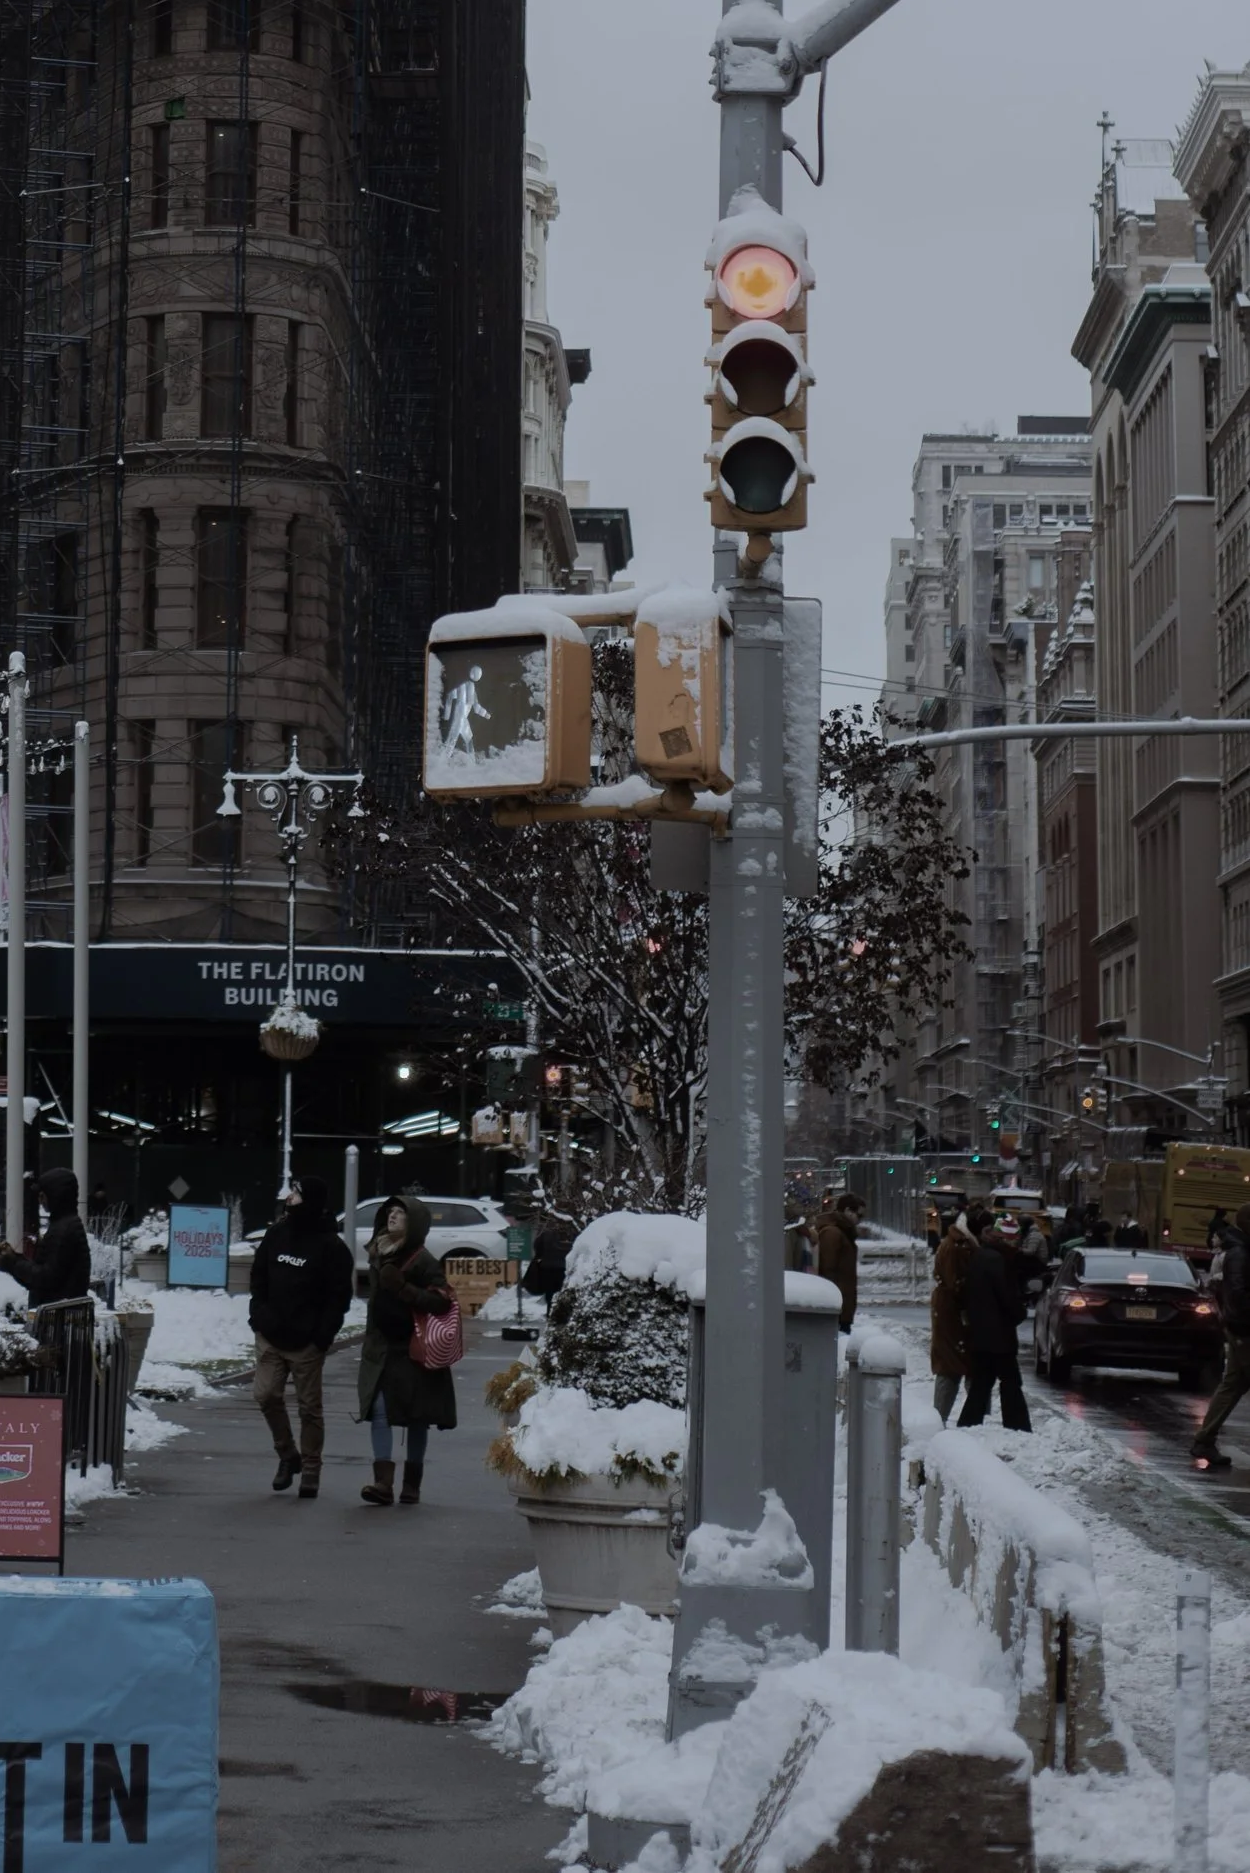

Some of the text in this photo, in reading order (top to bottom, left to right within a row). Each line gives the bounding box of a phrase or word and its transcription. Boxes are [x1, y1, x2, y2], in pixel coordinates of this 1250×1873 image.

[197, 962, 244, 980] THE
[184, 1244, 212, 1258] 2025
[449, 1260, 509, 1279] THE BEST
[63, 1742, 149, 1844] IN
